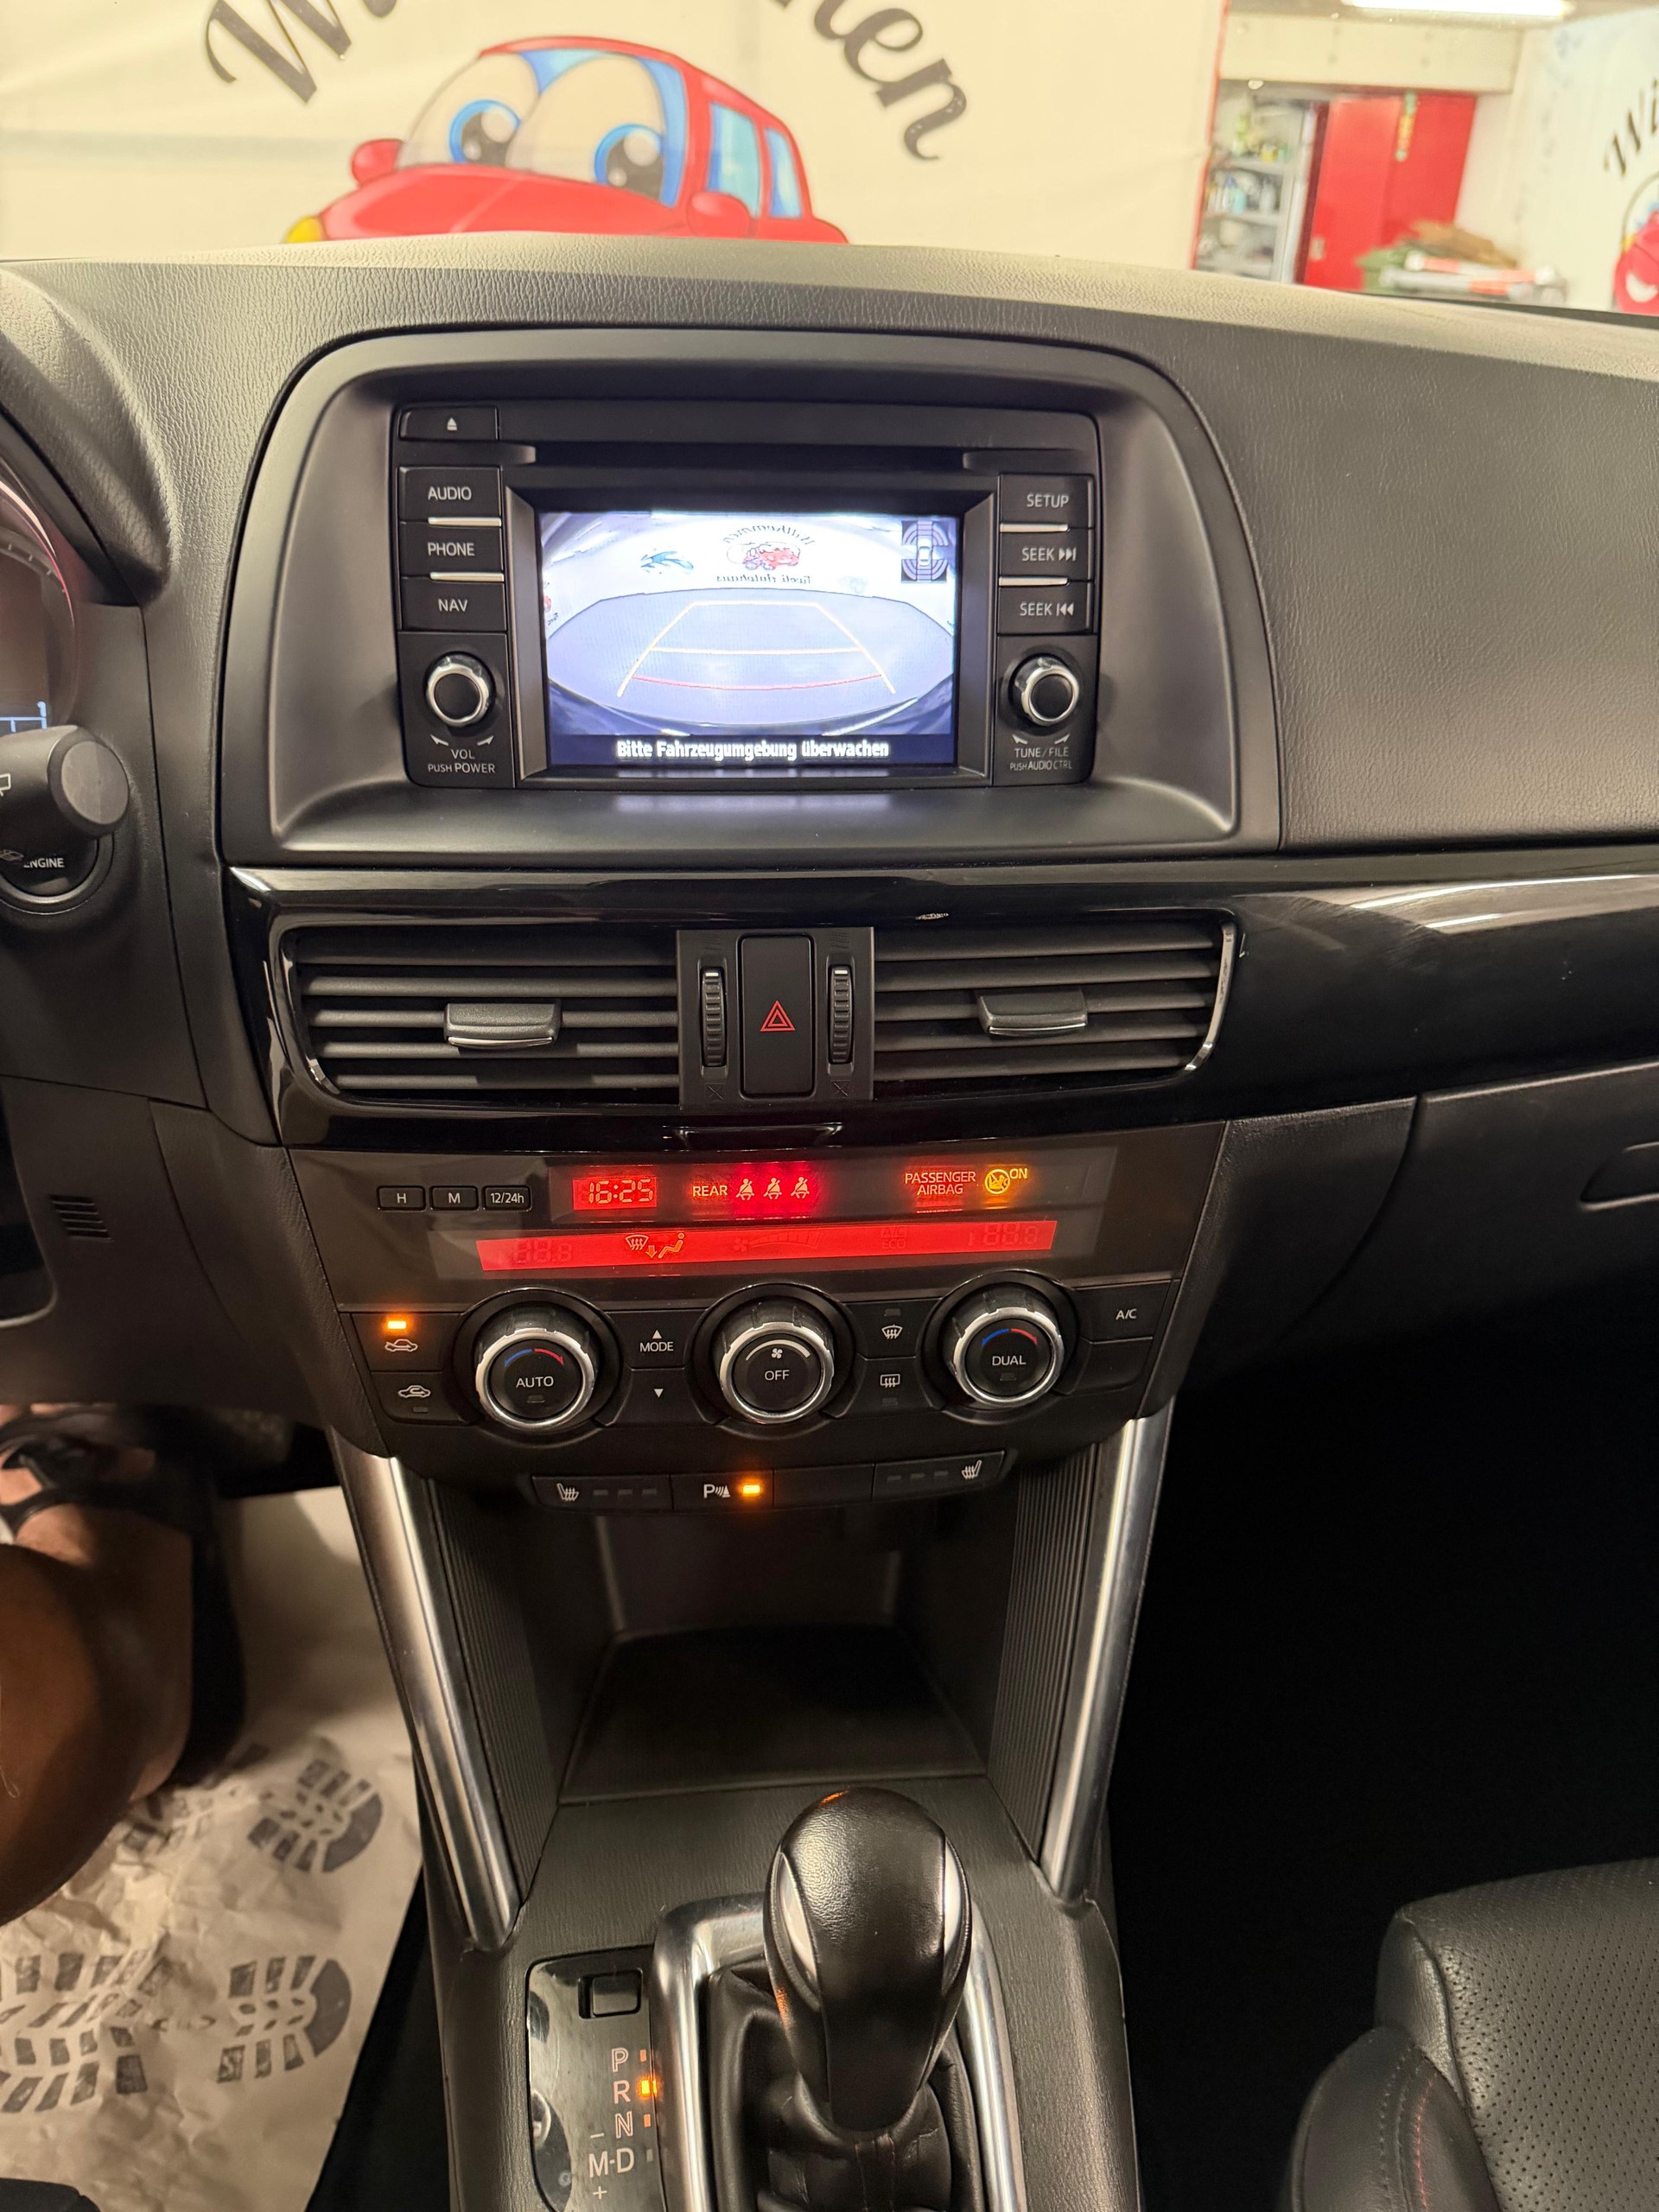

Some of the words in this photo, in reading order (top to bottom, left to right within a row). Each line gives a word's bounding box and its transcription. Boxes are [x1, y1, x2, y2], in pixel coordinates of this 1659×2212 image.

[428, 486, 472, 500] AUDIO
[1027, 493, 1070, 508] SETUP
[427, 542, 475, 556] PHONE
[1021, 547, 1055, 562] SEEK
[438, 598, 467, 613] NAV
[1020, 602, 1052, 616] SEEK
[451, 748, 475, 760] VOL
[616, 740, 653, 758] Bitte
[656, 740, 798, 762] Fahrzeugumgebung
[801, 740, 890, 758] überwachen
[428, 763, 452, 773] PUSH
[454, 762, 496, 774] POWER
[1009, 762, 1027, 771] PUSH
[1027, 760, 1052, 771] AUDIO
[23, 857, 65, 868] NGINE
[904, 1171, 976, 1185] PASSENGER
[1009, 1167, 1028, 1181] ON
[588, 1178, 654, 1205] 16:25
[692, 1184, 728, 1198] REAR
[917, 1183, 964, 1196] AIRBAG
[396, 1192, 407, 1204] H
[448, 1192, 461, 1204] M
[490, 1192, 524, 1204] 12/24h
[1116, 1307, 1138, 1320] A/C
[639, 1341, 674, 1353] MODE
[991, 1354, 1027, 1367] DUAL
[764, 1368, 791, 1381] OFF
[516, 1376, 555, 1389] AUTO
[611, 2047, 629, 2073] P
[613, 2079, 632, 2104] R
[614, 2110, 633, 2139] N
